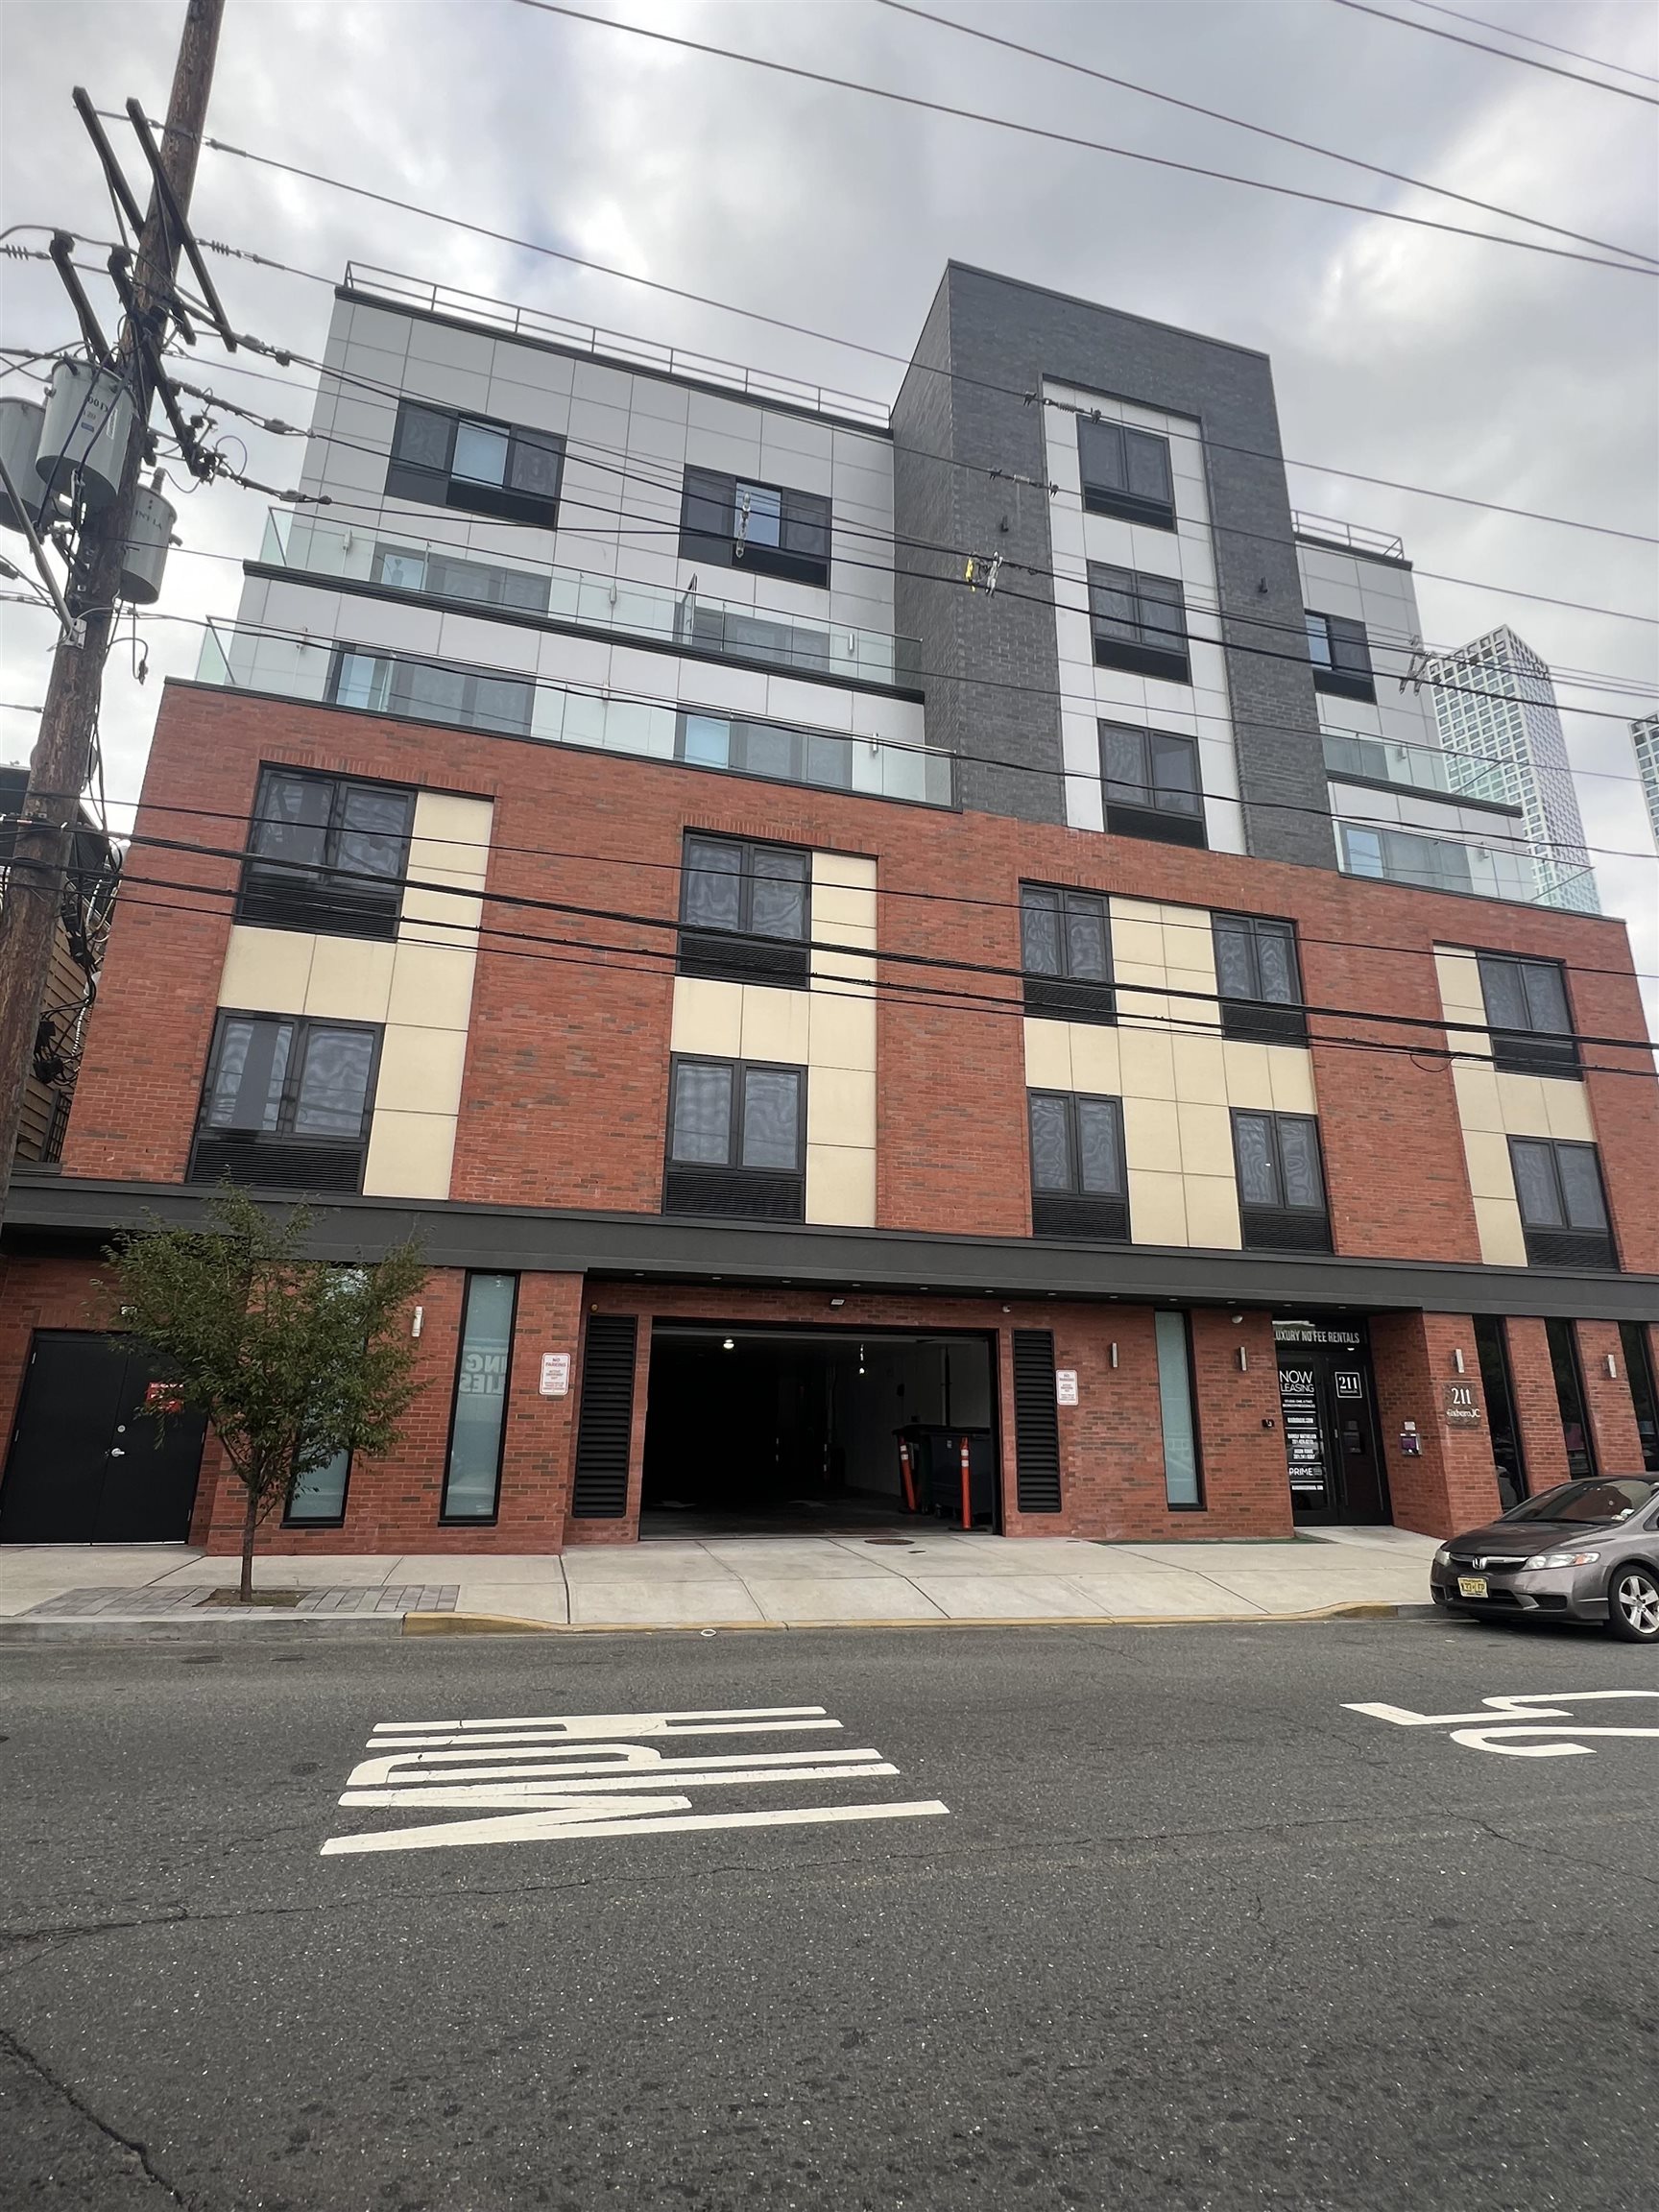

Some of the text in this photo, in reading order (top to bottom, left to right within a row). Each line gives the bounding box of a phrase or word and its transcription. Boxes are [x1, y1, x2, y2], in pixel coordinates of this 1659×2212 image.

[1301, 1331, 1312, 1342] NO
[1313, 1331, 1327, 1342] FEE
[1328, 1332, 1359, 1344] RENTALS
[1279, 1370, 1313, 1383] NOW
[1338, 1376, 1358, 1389] 211
[1280, 1382, 1315, 1393] LEASING
[1451, 1387, 1472, 1405] 211
[1288, 1467, 1314, 1477] PRIME
[320, 1706, 950, 1856] MPH
